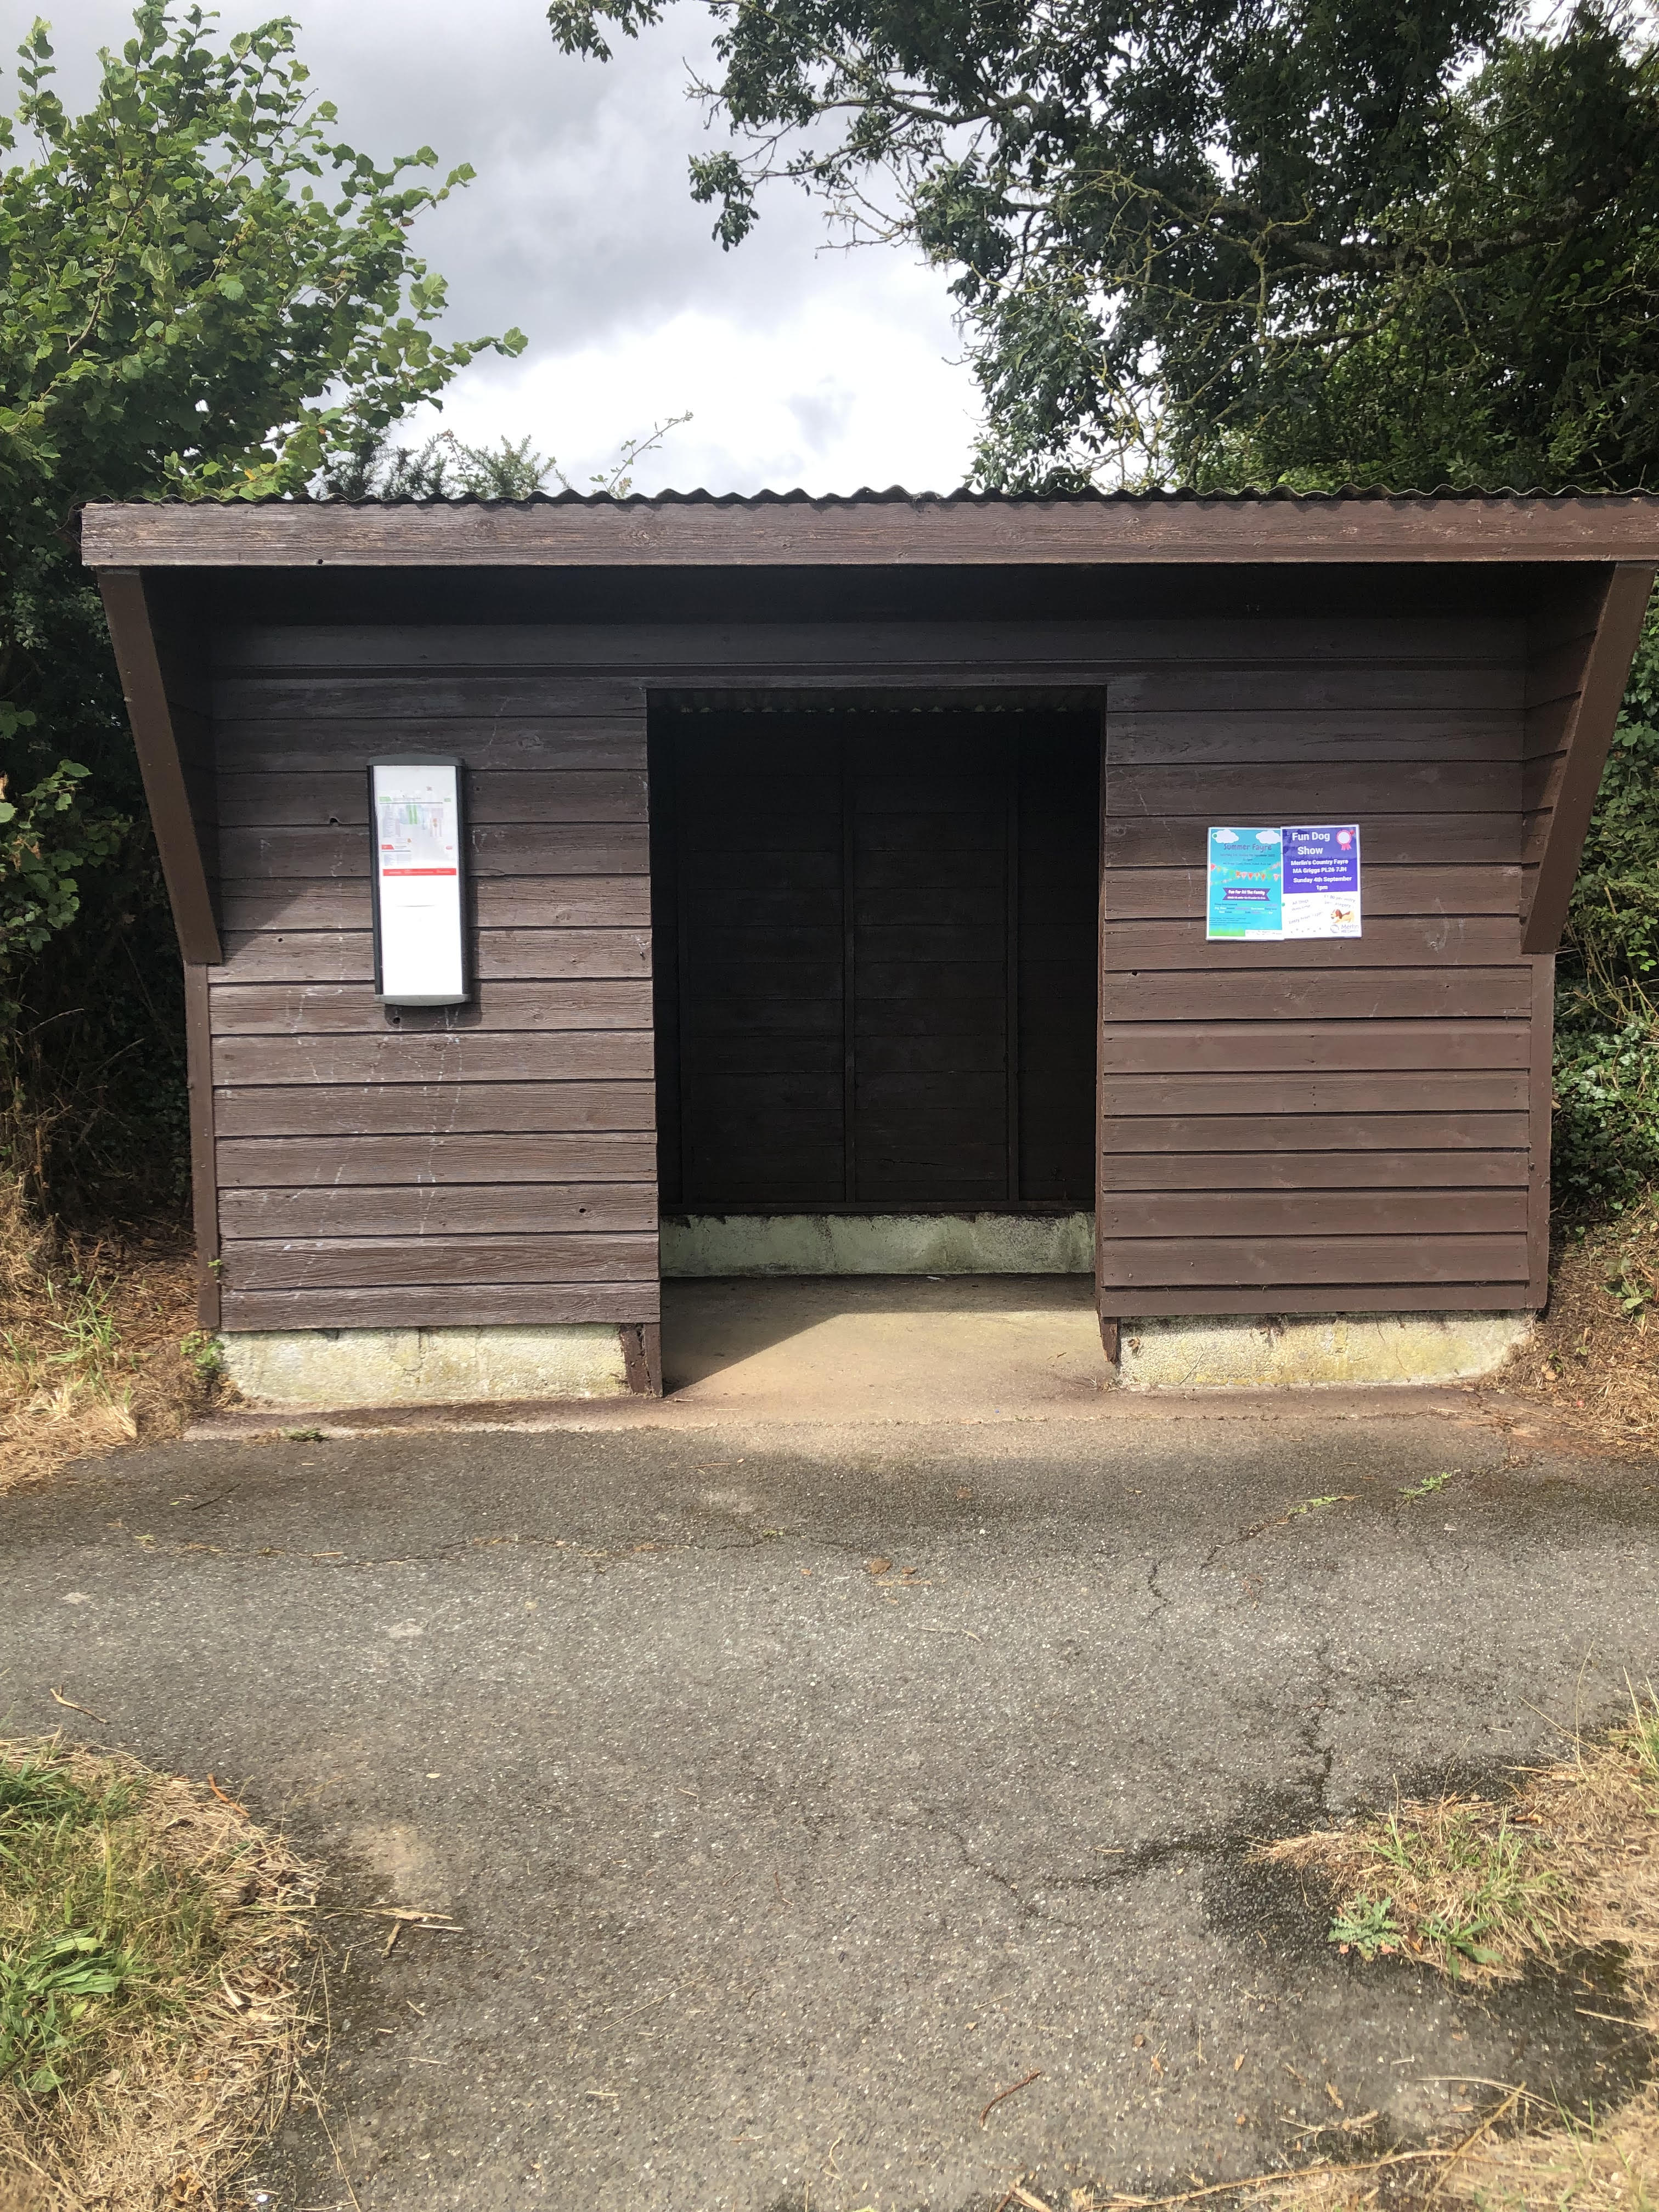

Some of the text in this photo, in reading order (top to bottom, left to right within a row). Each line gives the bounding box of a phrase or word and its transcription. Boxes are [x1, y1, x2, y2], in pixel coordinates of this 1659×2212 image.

[1292, 832, 1330, 842] Fun Dog
[1252, 844, 1272, 853] Fayre
[1297, 846, 1323, 855] Show
